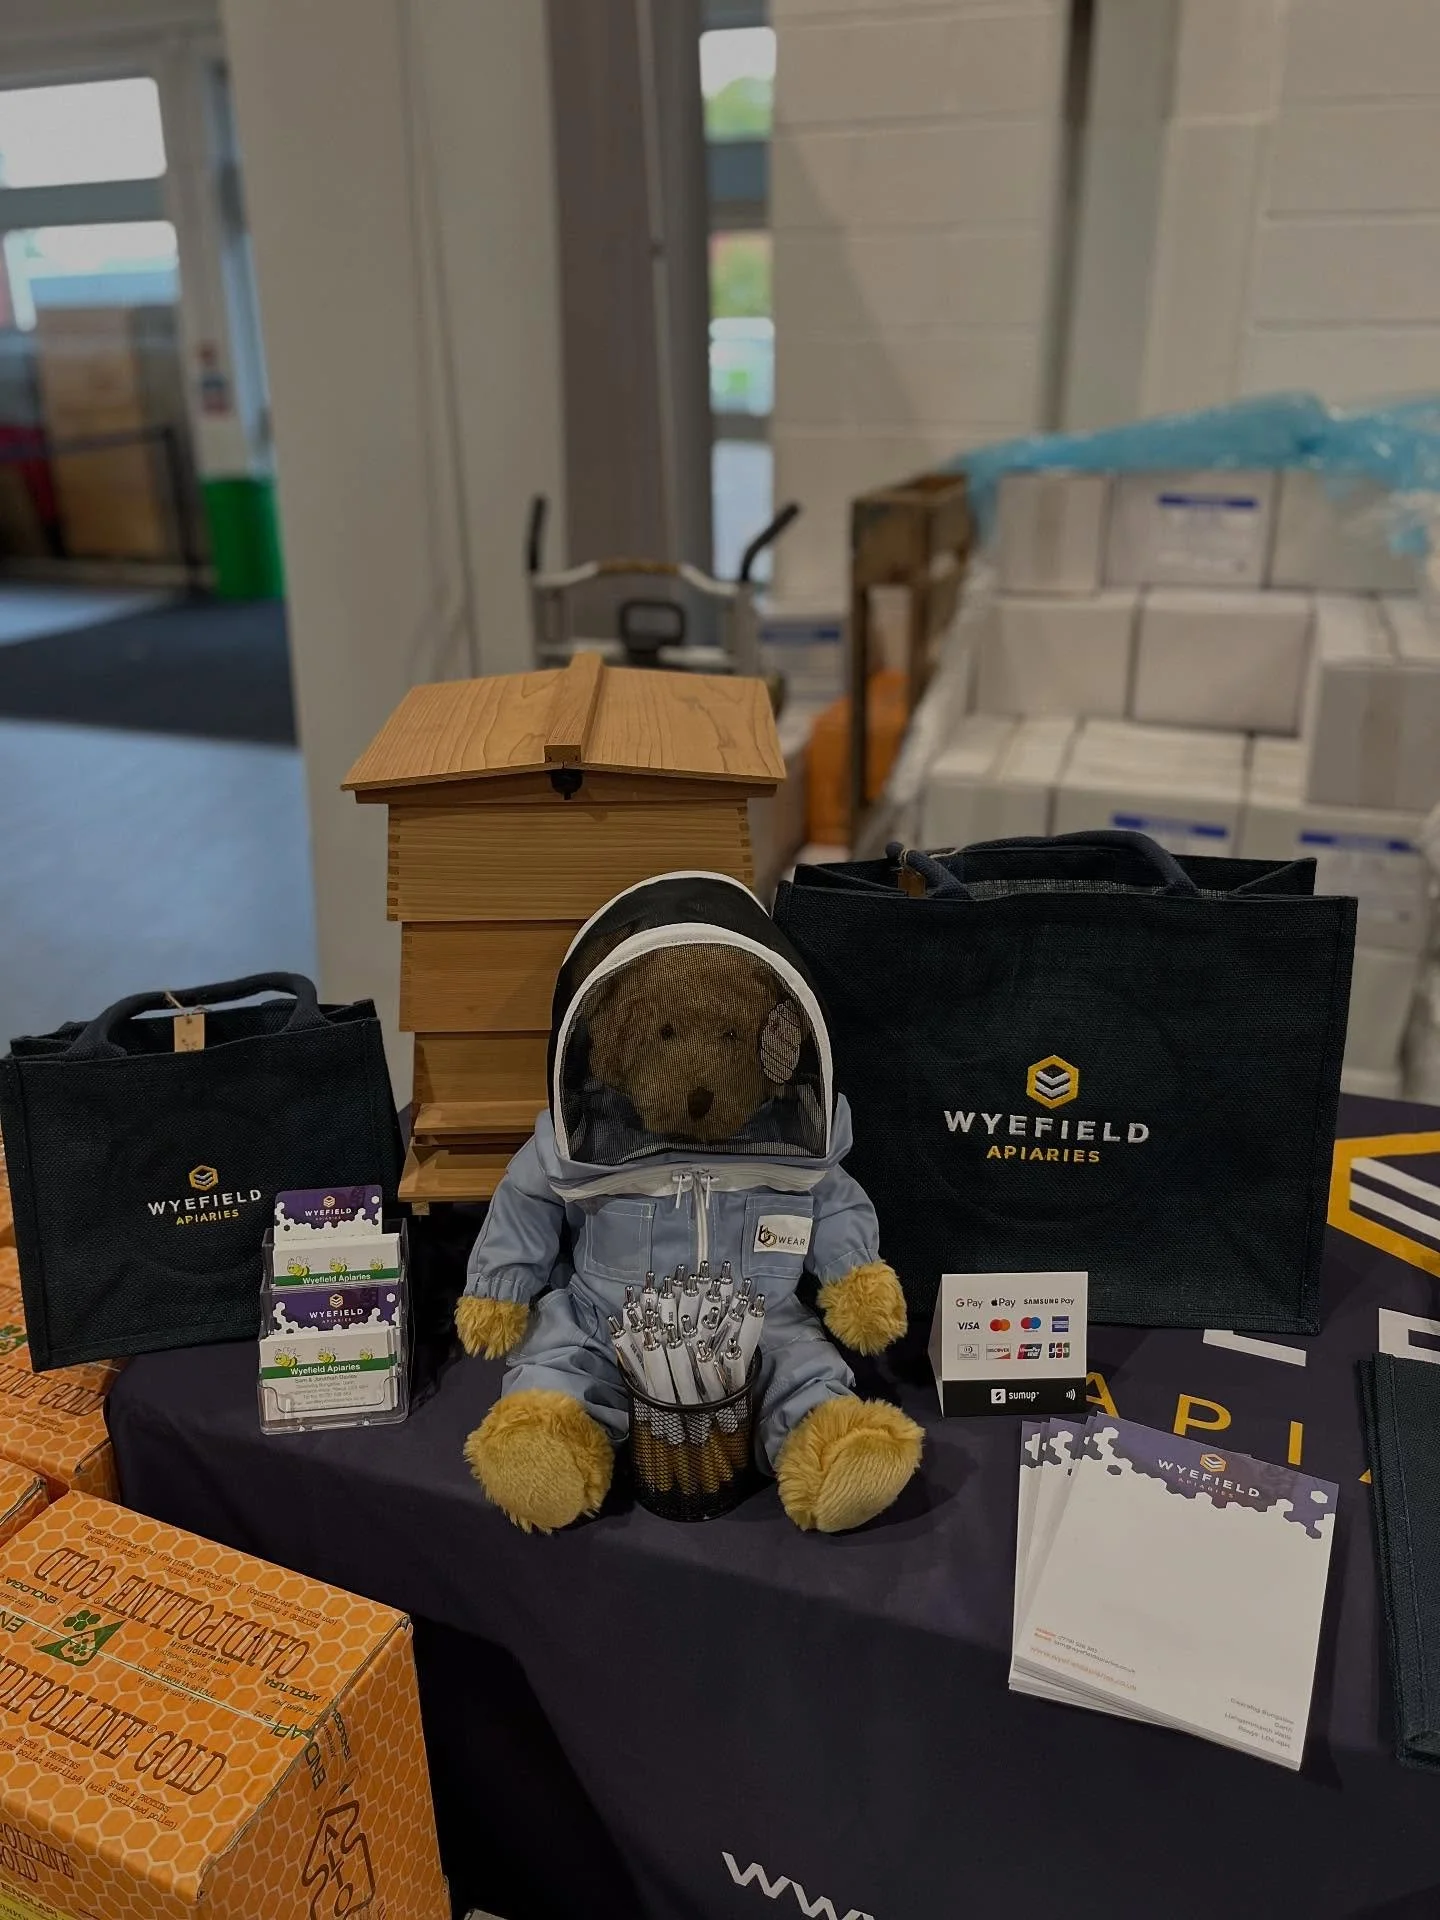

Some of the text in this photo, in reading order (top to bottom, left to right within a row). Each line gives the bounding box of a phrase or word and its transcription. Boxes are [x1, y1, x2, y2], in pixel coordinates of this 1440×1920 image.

[944, 1110, 1150, 1143] WYEFIELD
[986, 1145, 1100, 1163] APIARIES
[147, 1189, 262, 1216] WYEFIELD
[176, 1208, 240, 1226] APIARIES
[304, 1207, 352, 1218] WYEFIELD
[778, 1236, 805, 1245] WEAR
[302, 1273, 371, 1285] Wyefield Apiaries
[967, 1298, 983, 1309] Pay
[999, 1298, 1016, 1309] Pay
[1060, 1298, 1075, 1306] Pay
[309, 1308, 364, 1319] WYEFIELD
[957, 1321, 980, 1330] VISA
[290, 1363, 361, 1376] Wyefield Apiaries
[1008, 1391, 1038, 1402] sumup
[1158, 1459, 1260, 1497] WYEFIELD
[34, 1547, 116, 1599] GOLD
[134, 1731, 227, 1796] GOLD
[107, 1779, 130, 1793] SUGAR
[0, 1822, 75, 1880] OLLINE
[0, 1845, 38, 1883] OLD
